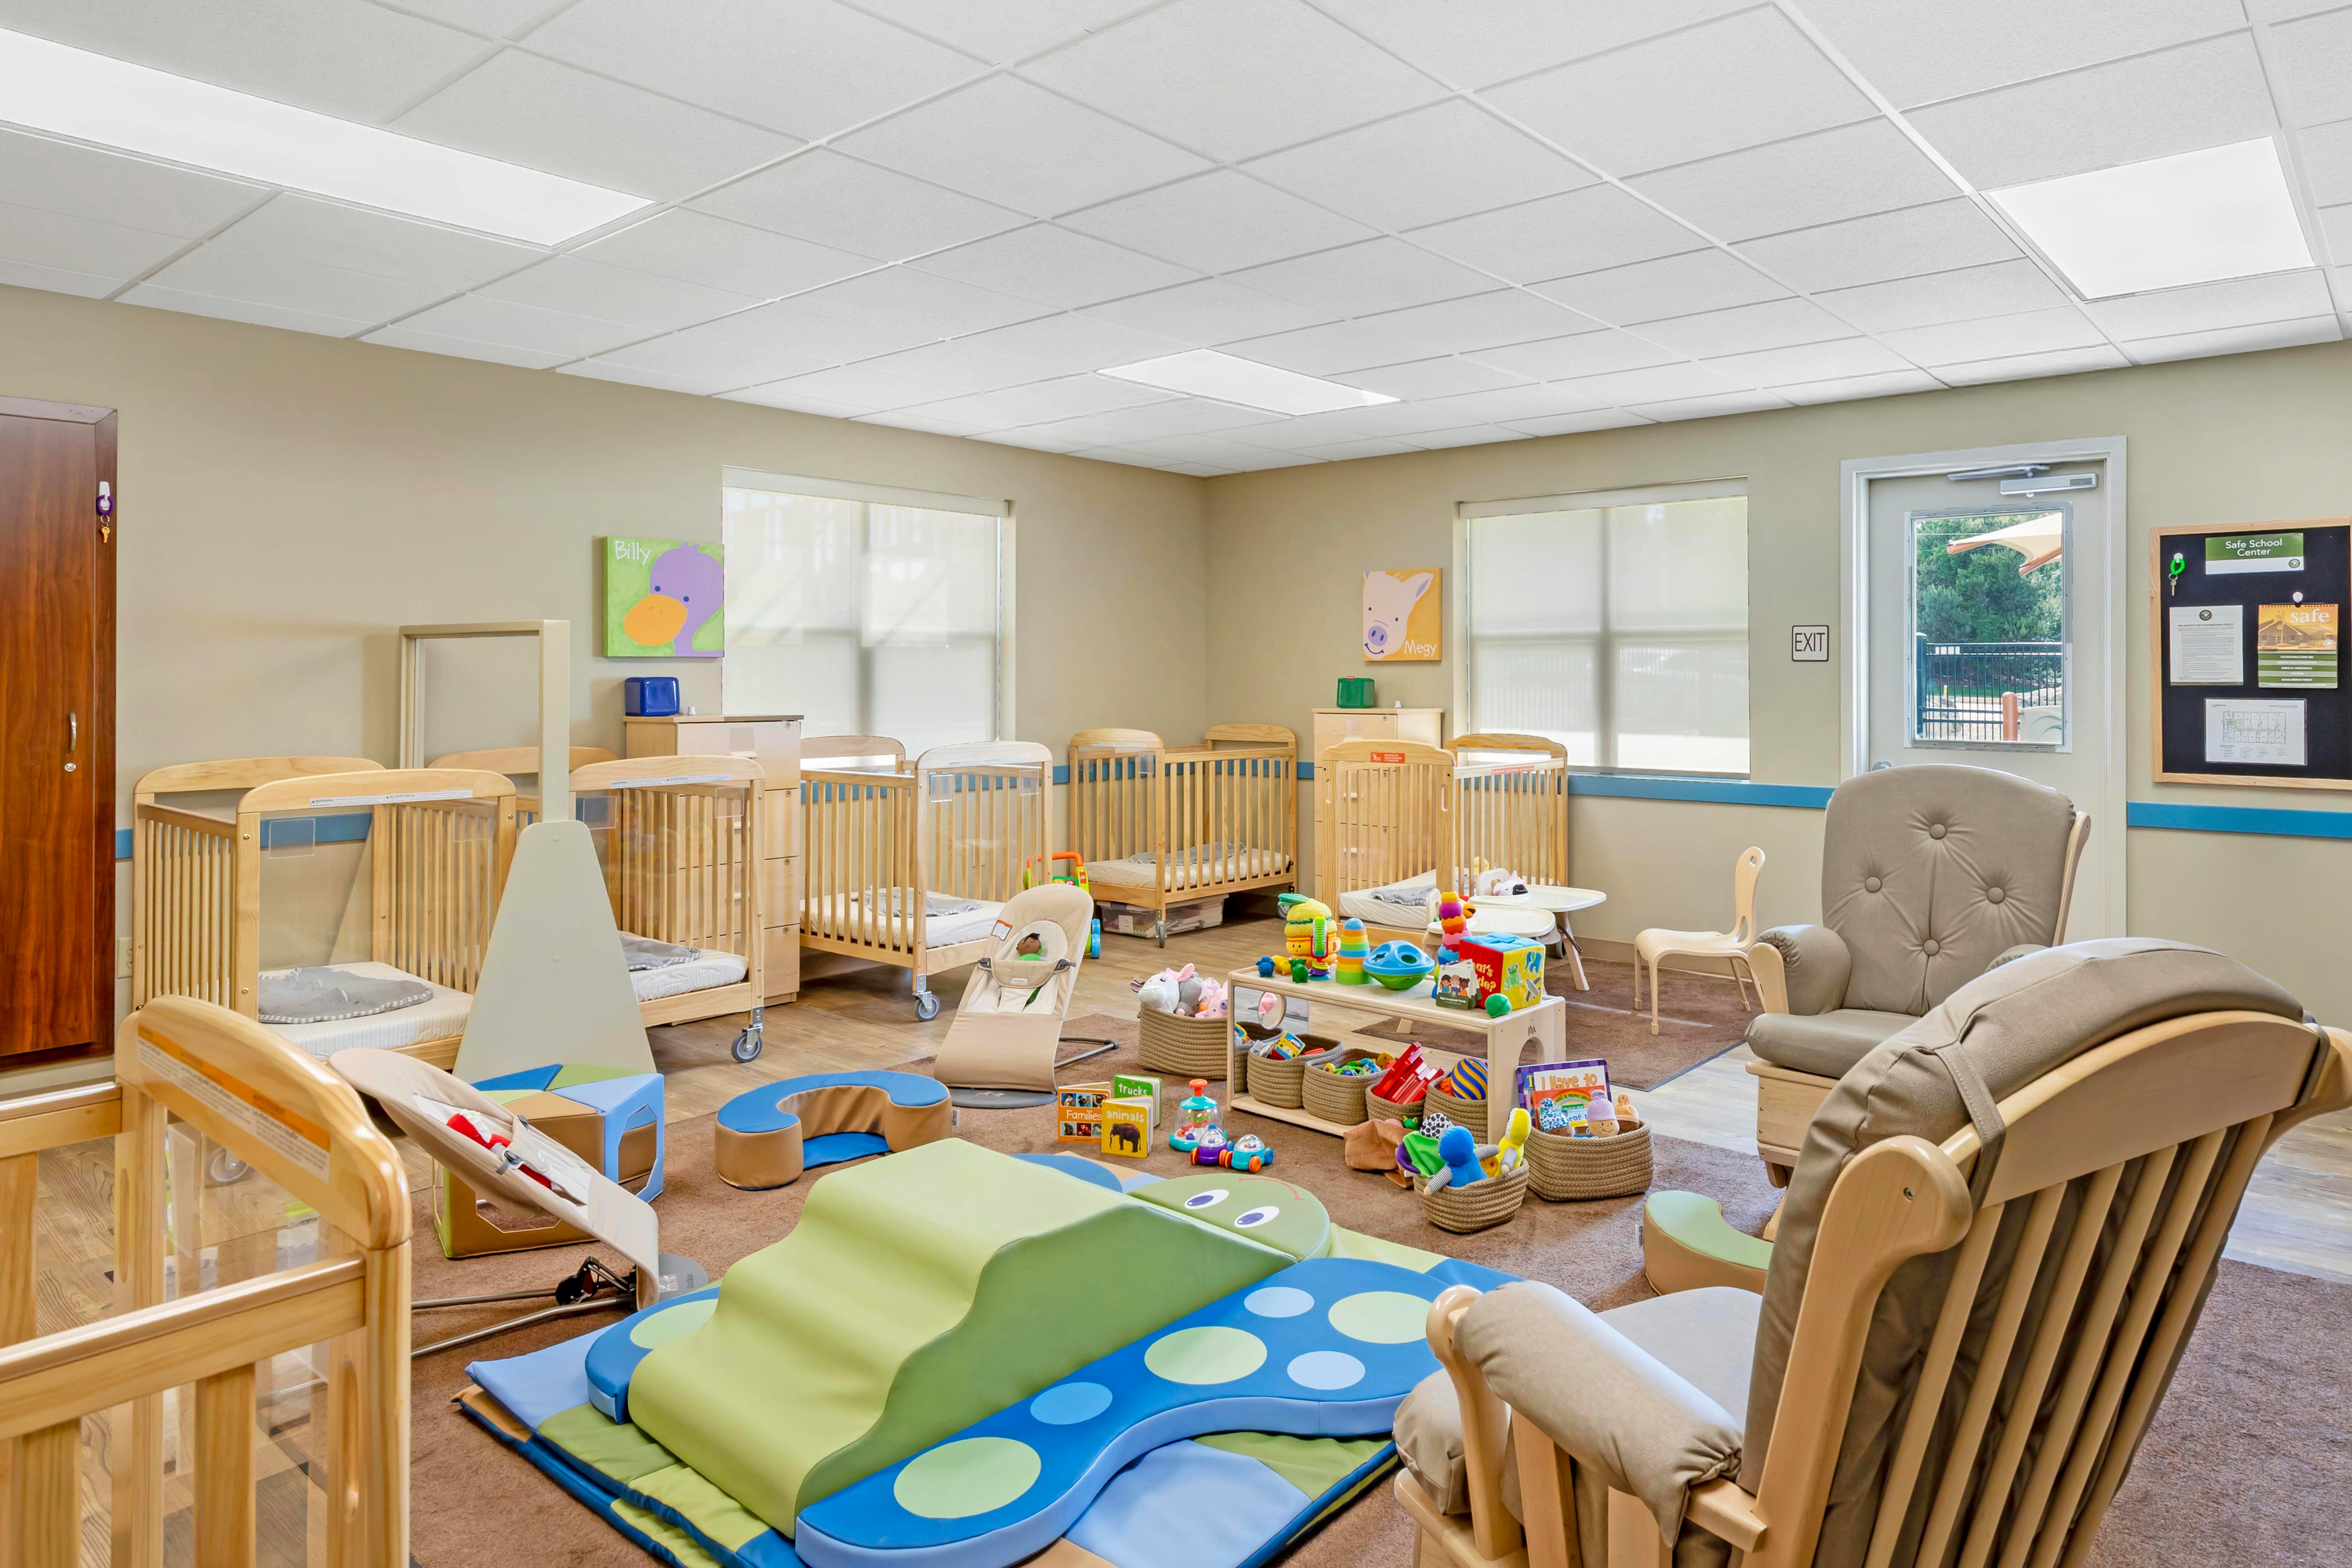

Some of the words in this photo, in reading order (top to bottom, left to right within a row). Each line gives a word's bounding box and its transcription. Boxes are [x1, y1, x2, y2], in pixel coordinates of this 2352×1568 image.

[2225, 540, 2246, 549] Safe
[2249, 538, 2282, 548] School
[614, 539, 651, 565] Billy
[2291, 608, 2329, 623] safe
[1404, 639, 1437, 657] Megy
[1795, 632, 1825, 652] EXIT
[1541, 1076, 1545, 1089] I
[1549, 1075, 1579, 1089] Have
[1583, 1073, 1598, 1086] 10
[1118, 1083, 1147, 1096] trucks
[1066, 1109, 1102, 1121] Families
[1106, 1109, 1144, 1122] animals
